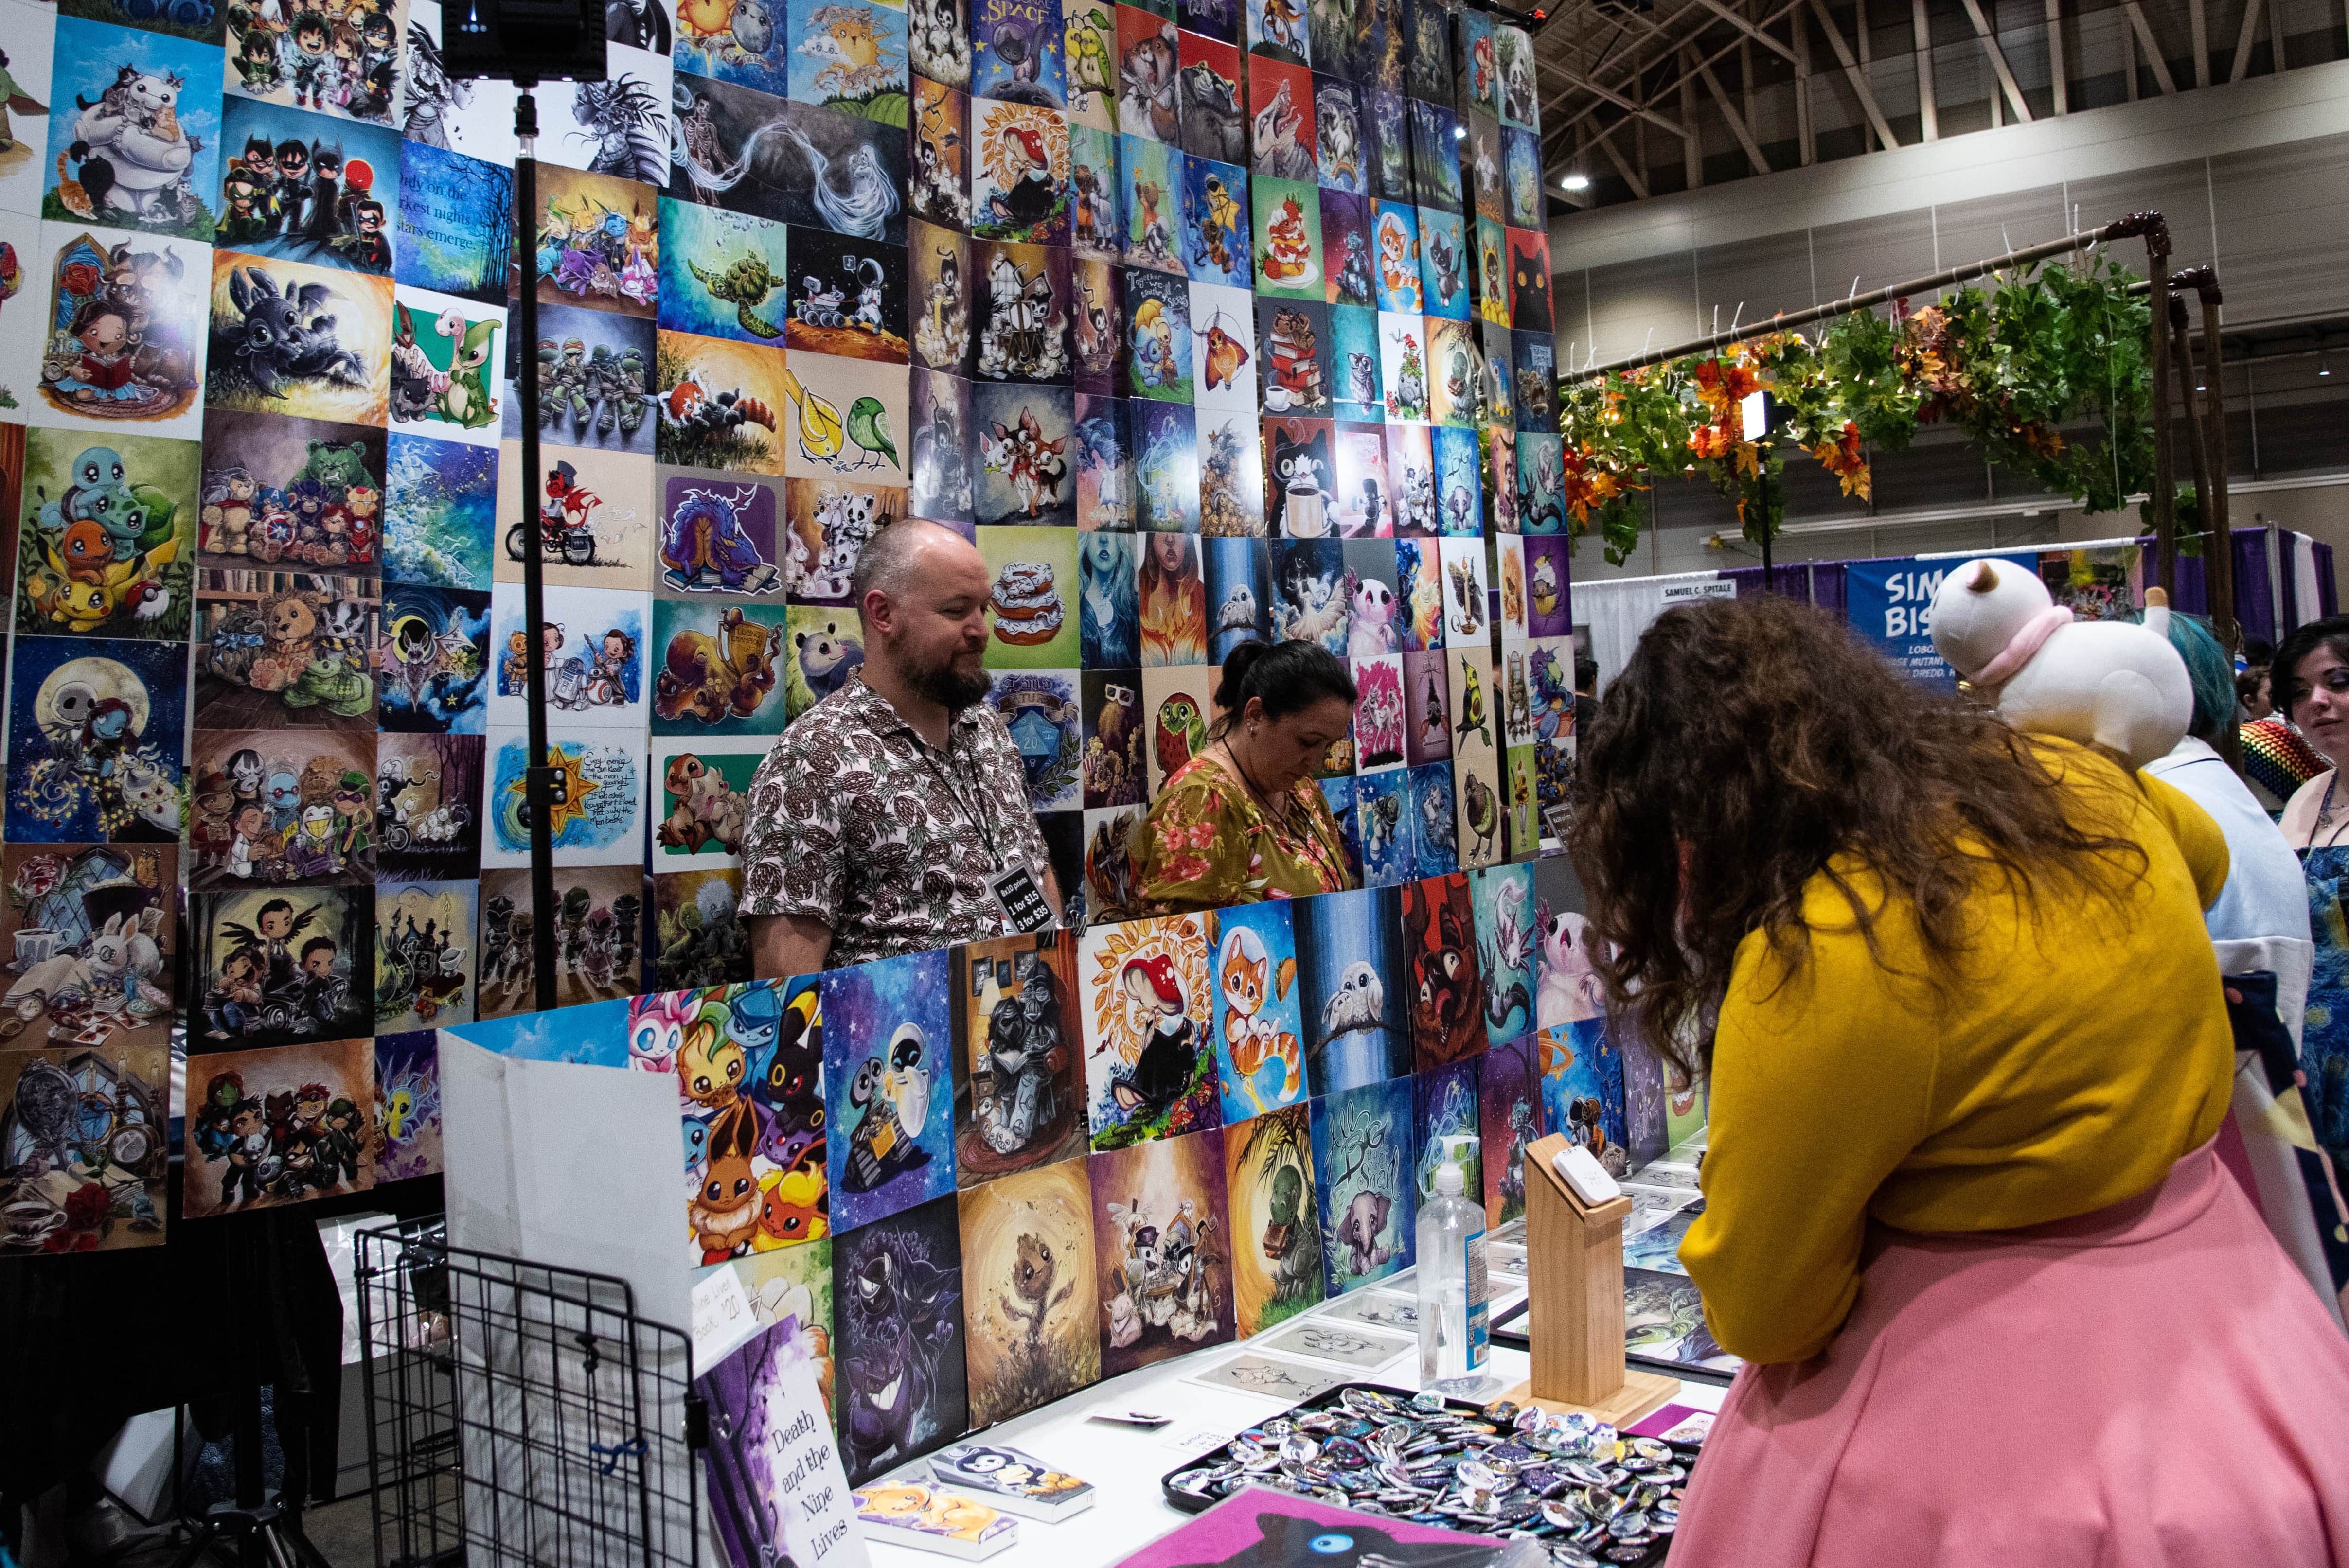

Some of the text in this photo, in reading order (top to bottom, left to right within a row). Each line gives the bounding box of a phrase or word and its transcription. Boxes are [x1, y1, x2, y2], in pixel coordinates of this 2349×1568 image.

[988, 0, 1049, 24] SPACE
[427, 183, 443, 195] on
[448, 185, 466, 201] the
[435, 206, 471, 226] nights
[427, 230, 476, 250] emerge.
[1126, 270, 1162, 292] Together
[1666, 587, 1692, 597] SAMUEL
[1704, 584, 1731, 593] SPITALE
[1885, 568, 1944, 604] SIM
[1024, 737, 1038, 749] 20
[584, 752, 632, 768] Every evening
[609, 806, 622, 819] why
[621, 806, 634, 814] the
[1000, 877, 1028, 897] 8x10 prints
[1009, 890, 1039, 916] 1 for $15
[1017, 905, 1048, 930] 3 for $35
[772, 1410, 816, 1454] Death
[783, 1445, 830, 1494] and the
[801, 1486, 834, 1522] Nine
[811, 1519, 848, 1561] Lives
